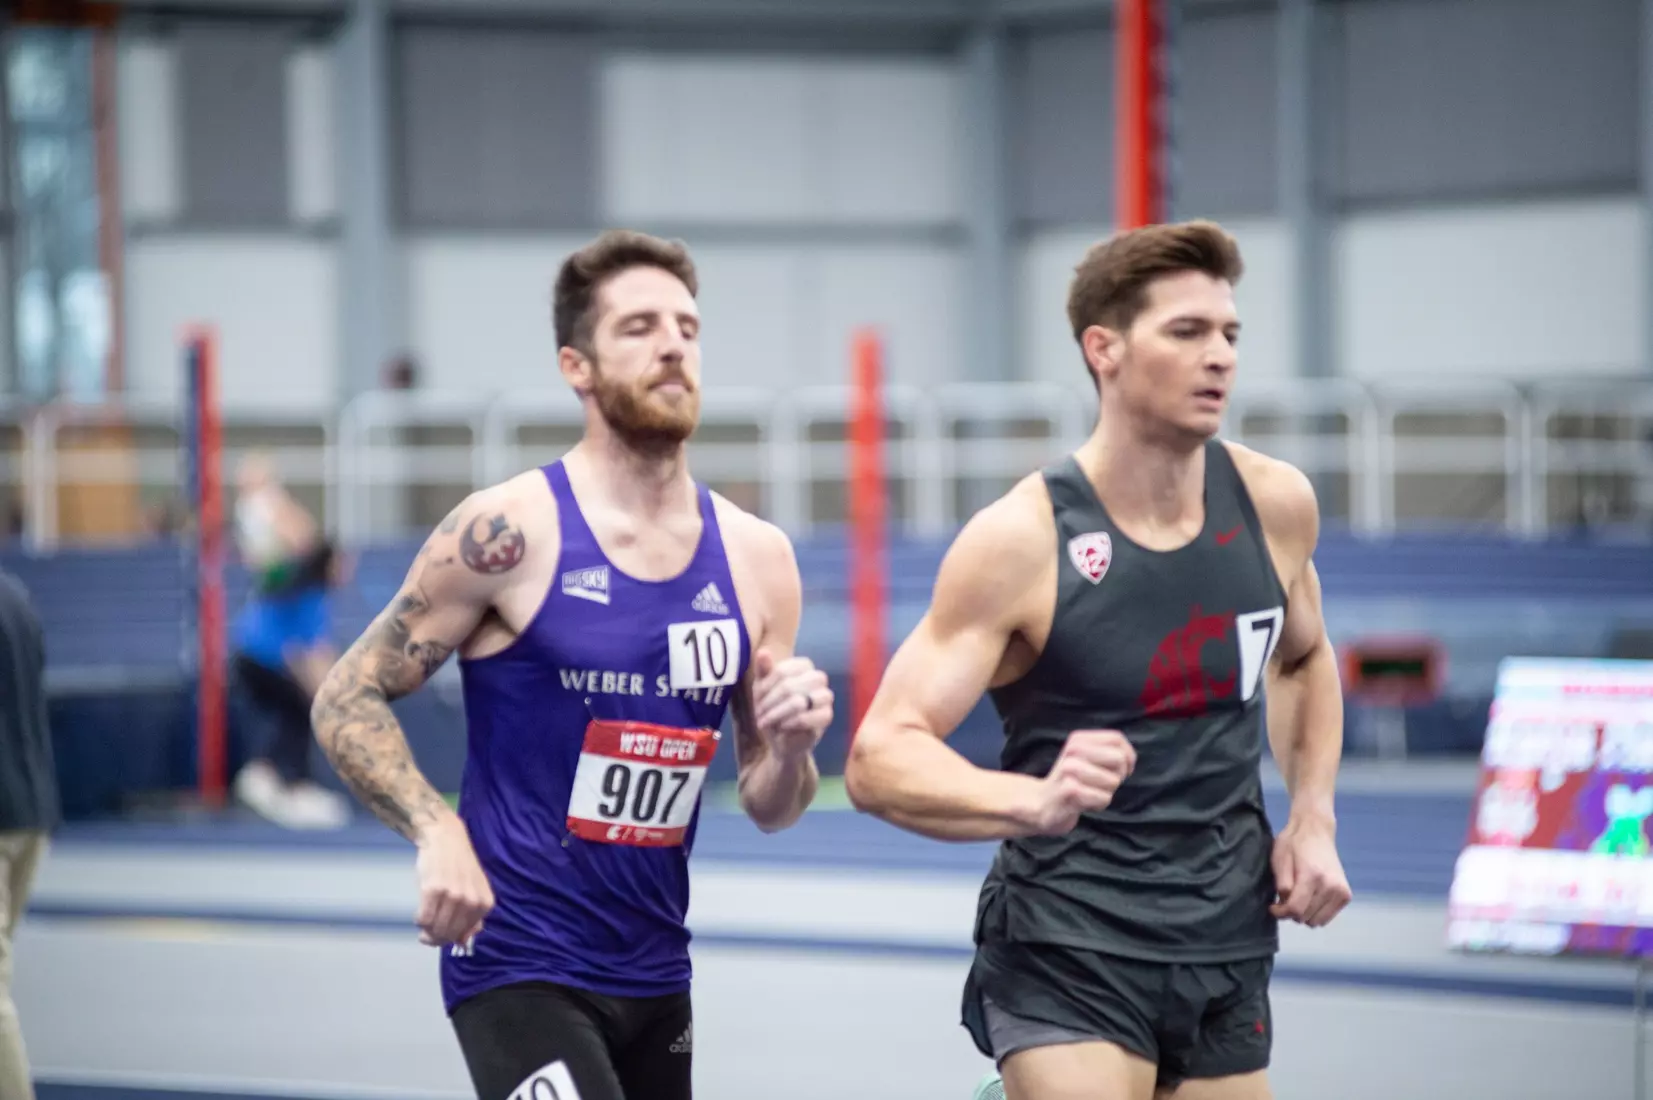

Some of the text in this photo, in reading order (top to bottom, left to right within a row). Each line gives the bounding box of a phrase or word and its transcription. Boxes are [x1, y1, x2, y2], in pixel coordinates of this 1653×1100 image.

[683, 626, 728, 682] 10
[1251, 616, 1276, 685] 7
[558, 668, 645, 697] WEBER
[620, 732, 698, 761] WSU OPEN
[597, 763, 691, 825] 907
